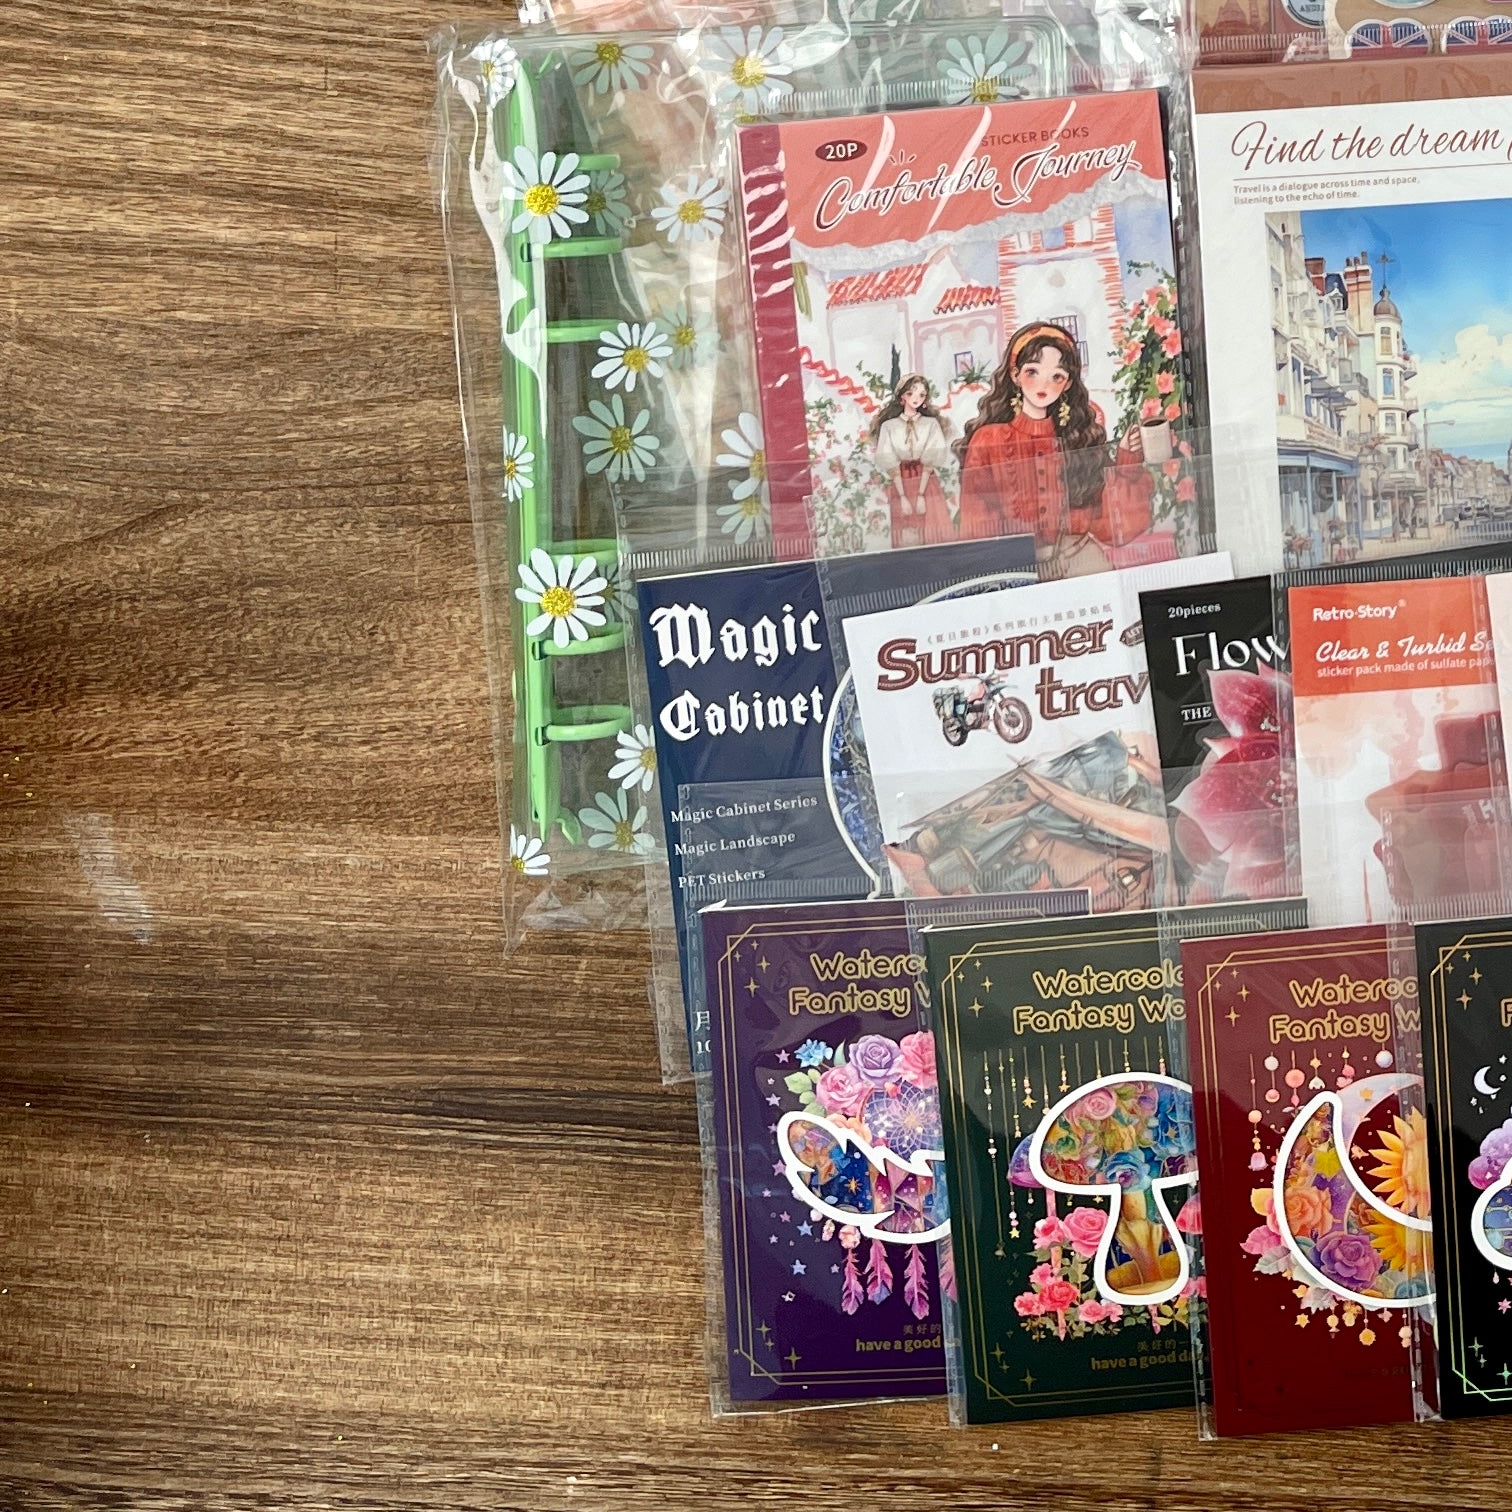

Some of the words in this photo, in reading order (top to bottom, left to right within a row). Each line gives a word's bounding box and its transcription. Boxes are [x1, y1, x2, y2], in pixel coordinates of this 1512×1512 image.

[825, 144, 858, 160] 20P
[981, 131, 1036, 148] STICKER
[1231, 121, 1325, 170] Find
[1331, 125, 1384, 160] the
[1390, 123, 1504, 157] dream
[815, 155, 996, 231] Comfortable
[994, 141, 1141, 207] Journey
[1233, 185, 1261, 194] Travel
[1262, 184, 1270, 192] is
[1279, 181, 1318, 193] dialogue
[1320, 181, 1349, 189] across
[1351, 178, 1371, 187] time
[1373, 176, 1389, 185] and
[1234, 194, 1273, 205] listening
[1274, 194, 1284, 203] to
[1286, 193, 1301, 201] the
[1302, 192, 1324, 200] echo
[1325, 191, 1335, 199] of
[1168, 603, 1222, 619] 20pieces
[649, 602, 822, 669] Magic
[1316, 640, 1370, 663] Clear
[1376, 641, 1390, 659] &
[1397, 631, 1466, 657] Turbid
[877, 617, 1113, 691] Summer
[1317, 665, 1353, 678] sticker
[1356, 662, 1382, 677] pack
[1384, 660, 1414, 673] made
[1417, 658, 1428, 669] of
[659, 685, 824, 742] Cabinet
[1181, 706, 1212, 721] THE
[671, 805, 714, 823] Magic
[716, 799, 771, 818] Cabinet
[774, 795, 818, 812] Series
[674, 838, 717, 856] Magic
[720, 830, 796, 851] Landscape
[678, 874, 706, 889] PET
[709, 868, 766, 886] Stickers
[788, 982, 911, 1018] Fantasy
[1013, 1000, 1135, 1035] Fantasy
[1269, 1009, 1390, 1044] Fantasy
[856, 1338, 891, 1352] have
[893, 1340, 902, 1350] a
[904, 1335, 941, 1353] good
[1091, 1357, 1126, 1370] have
[1129, 1357, 1138, 1367] a
[1140, 1351, 1176, 1369] good
